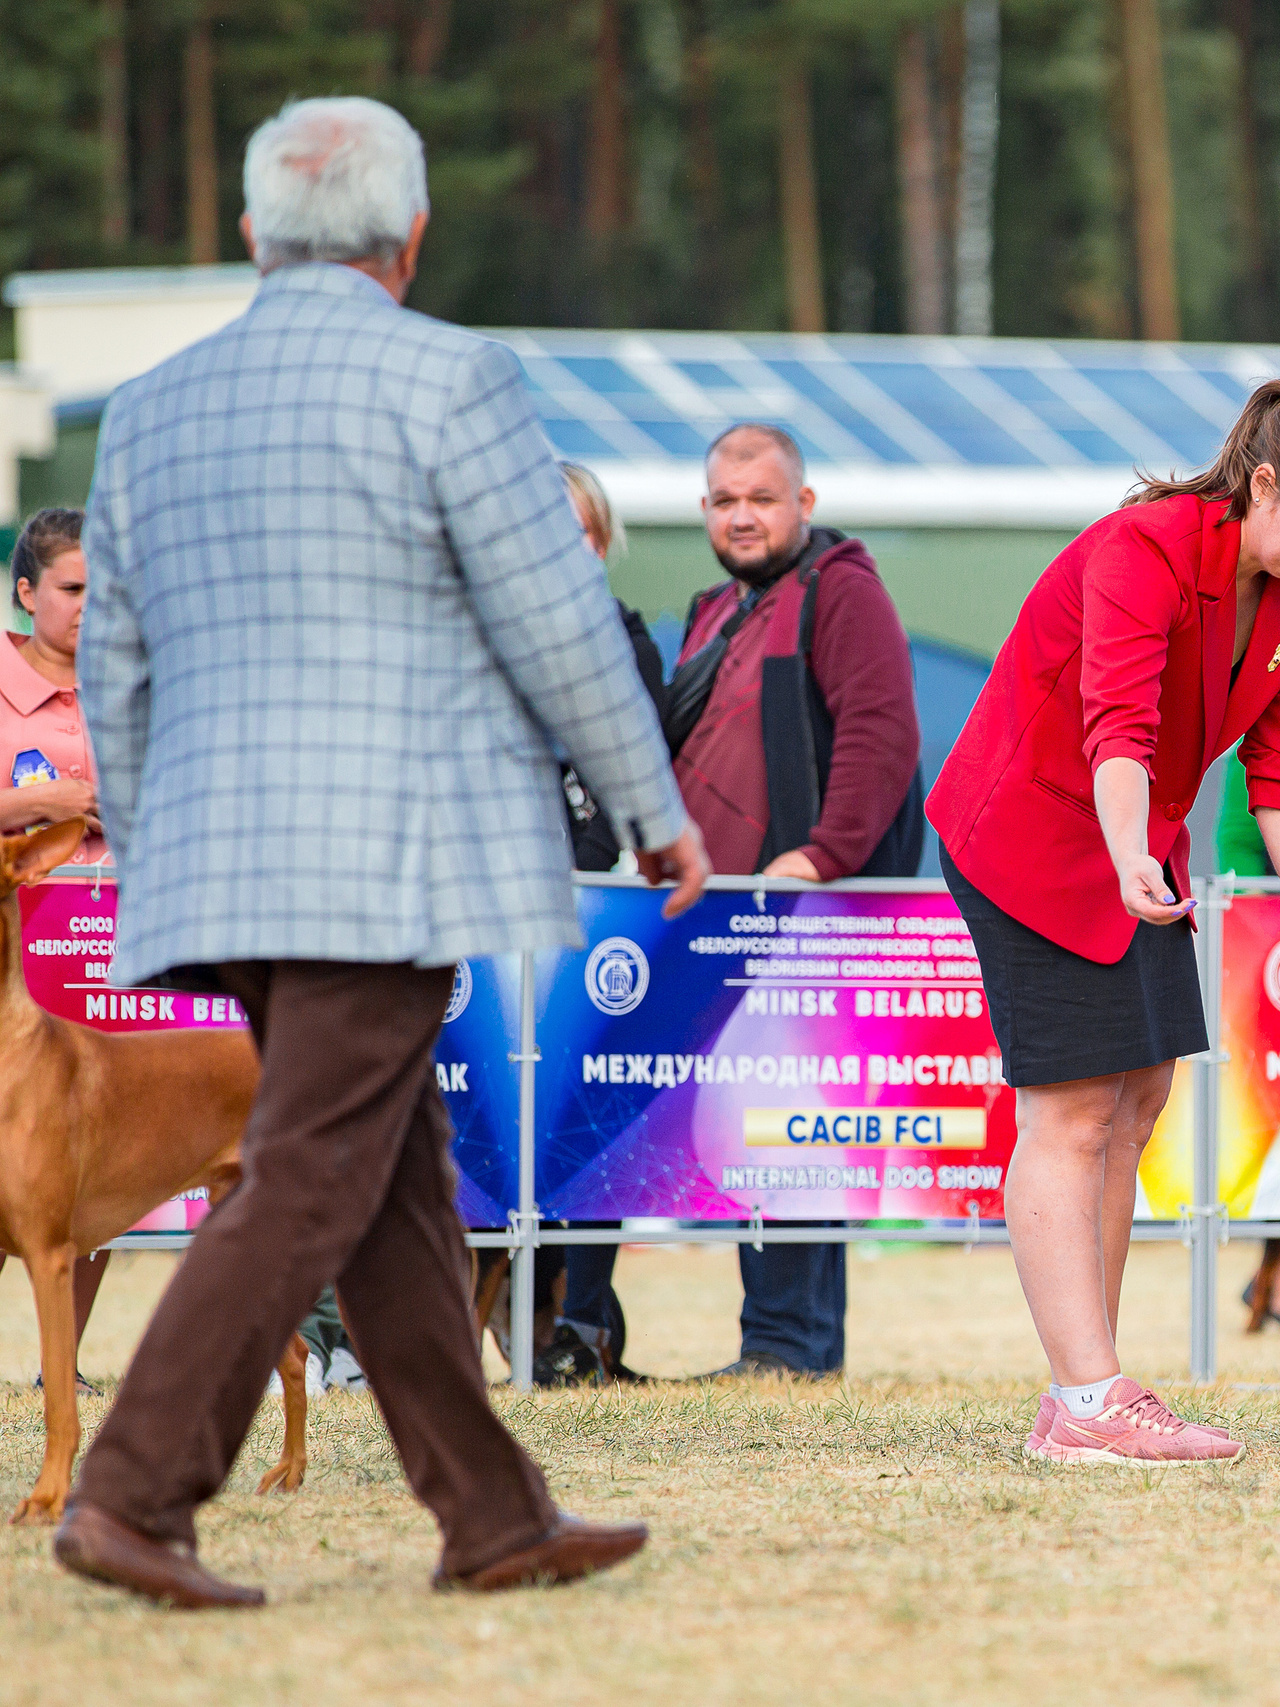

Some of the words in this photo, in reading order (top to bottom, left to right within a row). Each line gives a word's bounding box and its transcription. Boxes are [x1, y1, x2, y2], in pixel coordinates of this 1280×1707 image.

[69, 916, 114, 934] СОЮЗ
[86, 994, 175, 1021] MINSK
[193, 998, 249, 1022] BEL
[745, 989, 837, 1017] MINSK
[855, 990, 983, 1018] BELARUS
[583, 1054, 860, 1088] МЕЖДУНАРОДНАЯ
[788, 1115, 882, 1144] CACIB
[895, 1115, 943, 1144] FCI
[722, 1165, 880, 1190] INTERNATIONAL
[884, 1165, 935, 1190] DOG
[936, 1165, 1003, 1190] SHOW
